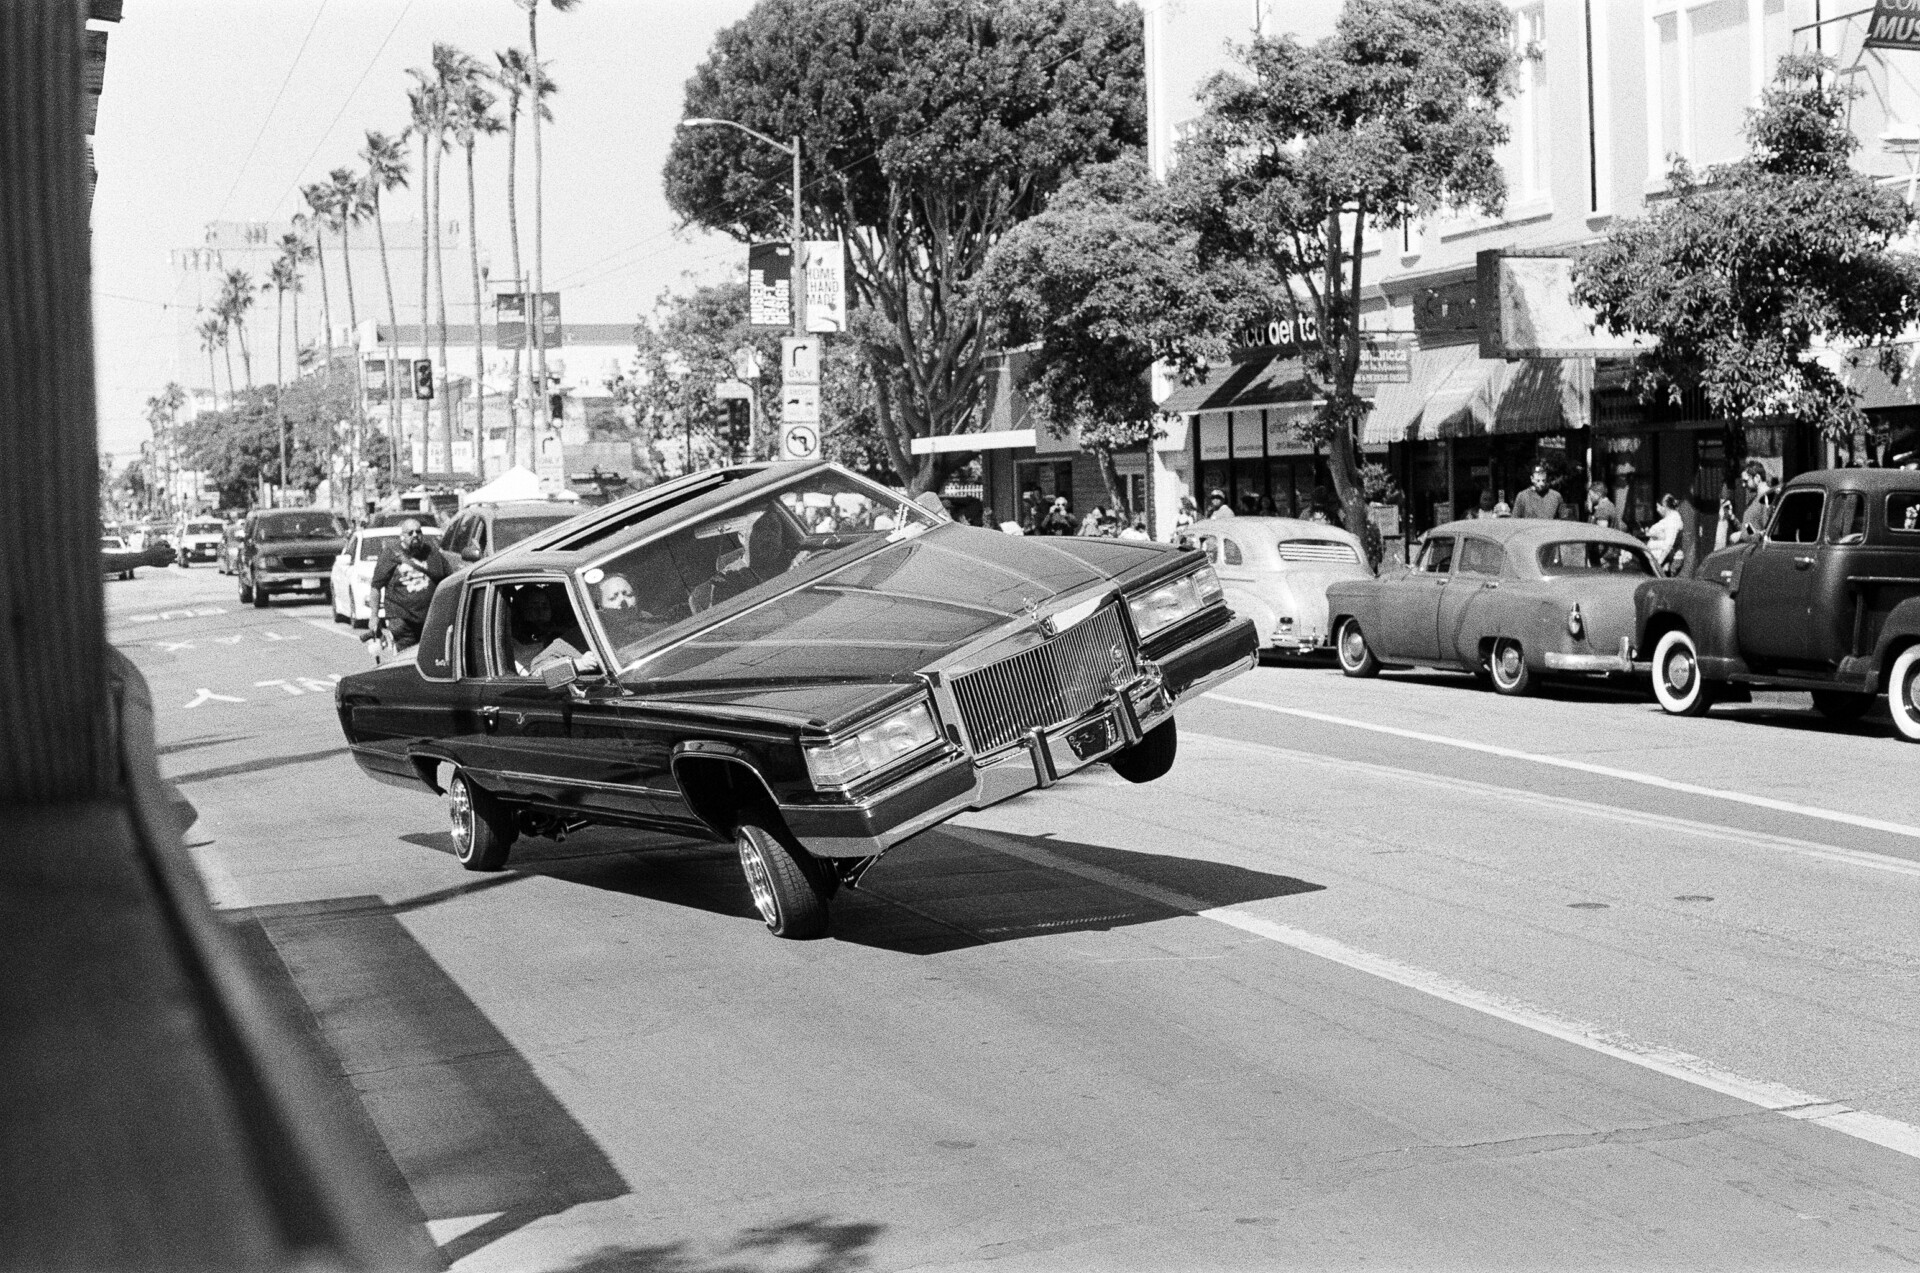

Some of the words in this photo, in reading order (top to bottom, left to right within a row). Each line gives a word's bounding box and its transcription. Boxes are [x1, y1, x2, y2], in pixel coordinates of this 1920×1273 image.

[750, 269, 765, 324] MUSEUM
[763, 286, 777, 324] CRAFT
[775, 279, 790, 324] DESIGN
[810, 281, 839, 293] HAND
[788, 369, 813, 378] ONLY
